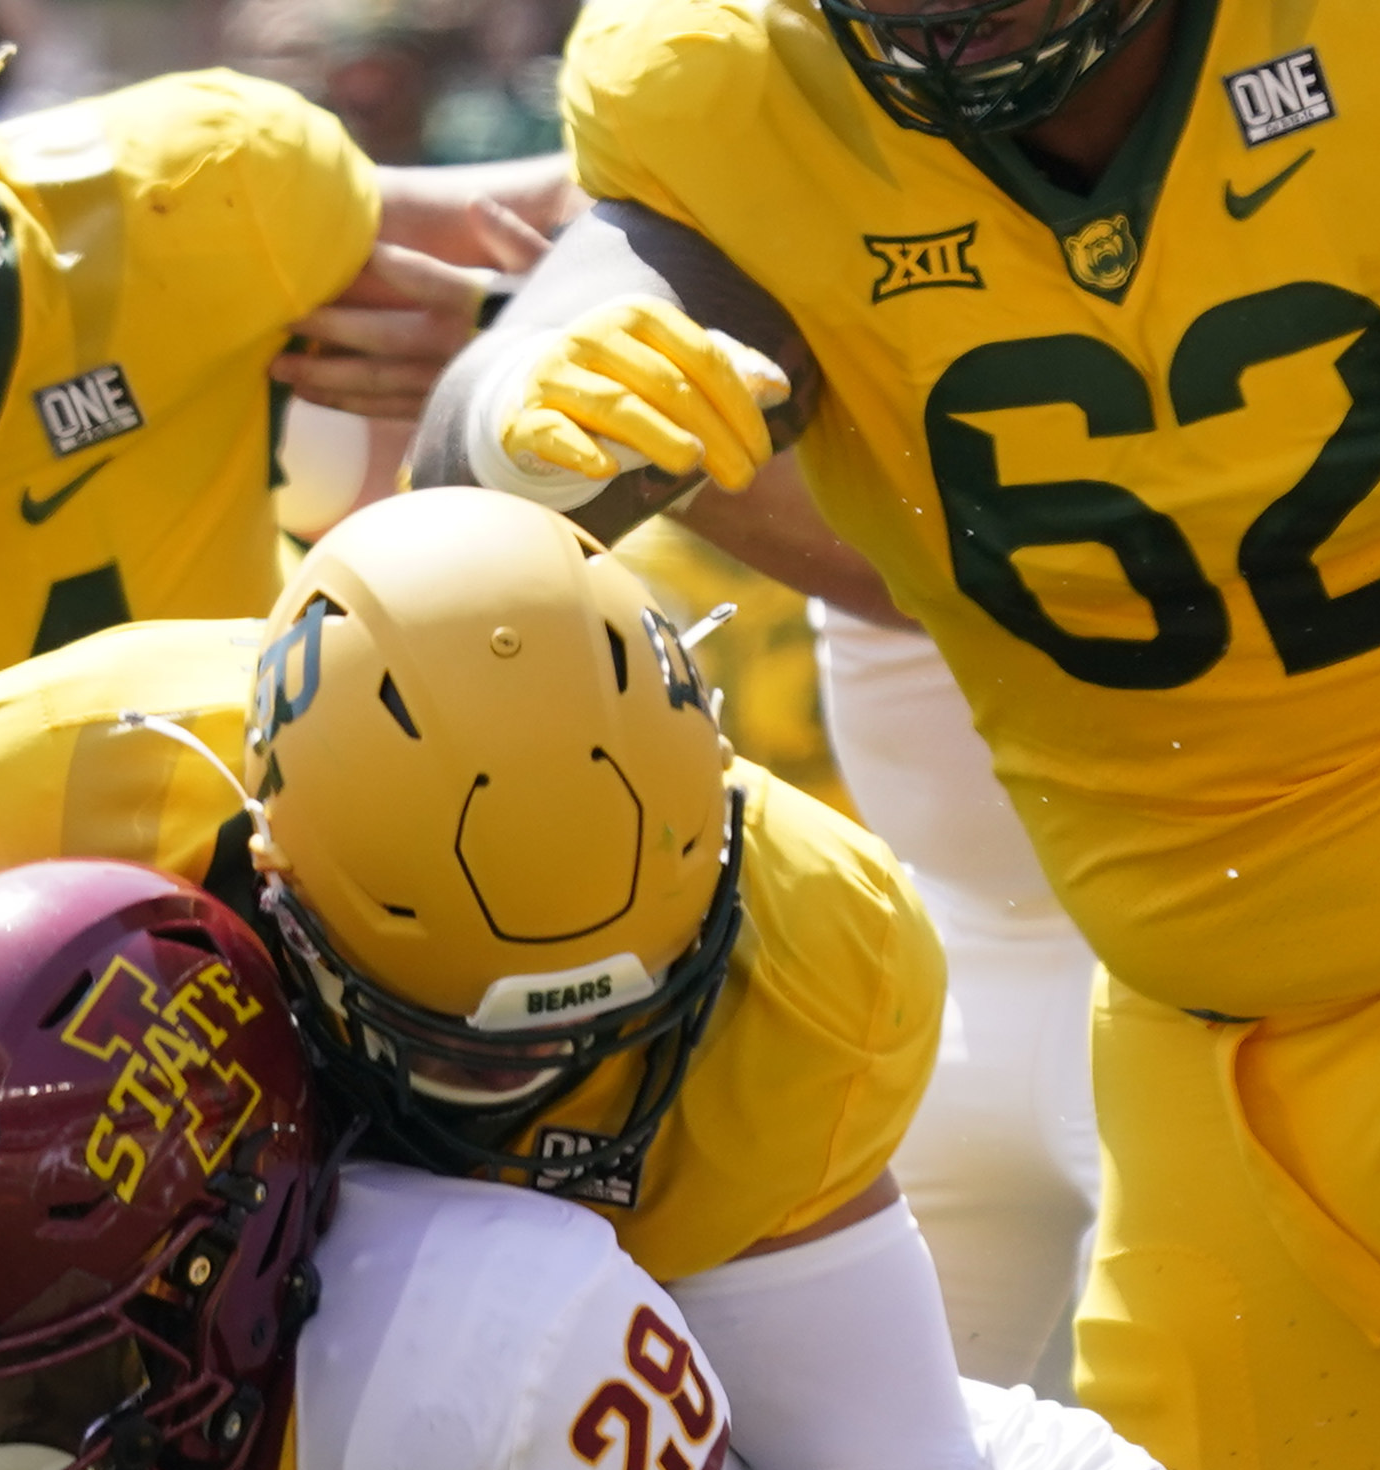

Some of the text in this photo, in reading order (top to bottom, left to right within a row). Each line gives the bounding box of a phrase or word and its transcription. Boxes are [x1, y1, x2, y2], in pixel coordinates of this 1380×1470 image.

[1233, 52, 1327, 126] ONE
[862, 220, 987, 305] XII
[43, 365, 135, 440] ONE
[526, 973, 613, 1015] BEARS
[85, 961, 264, 1204] STATE
